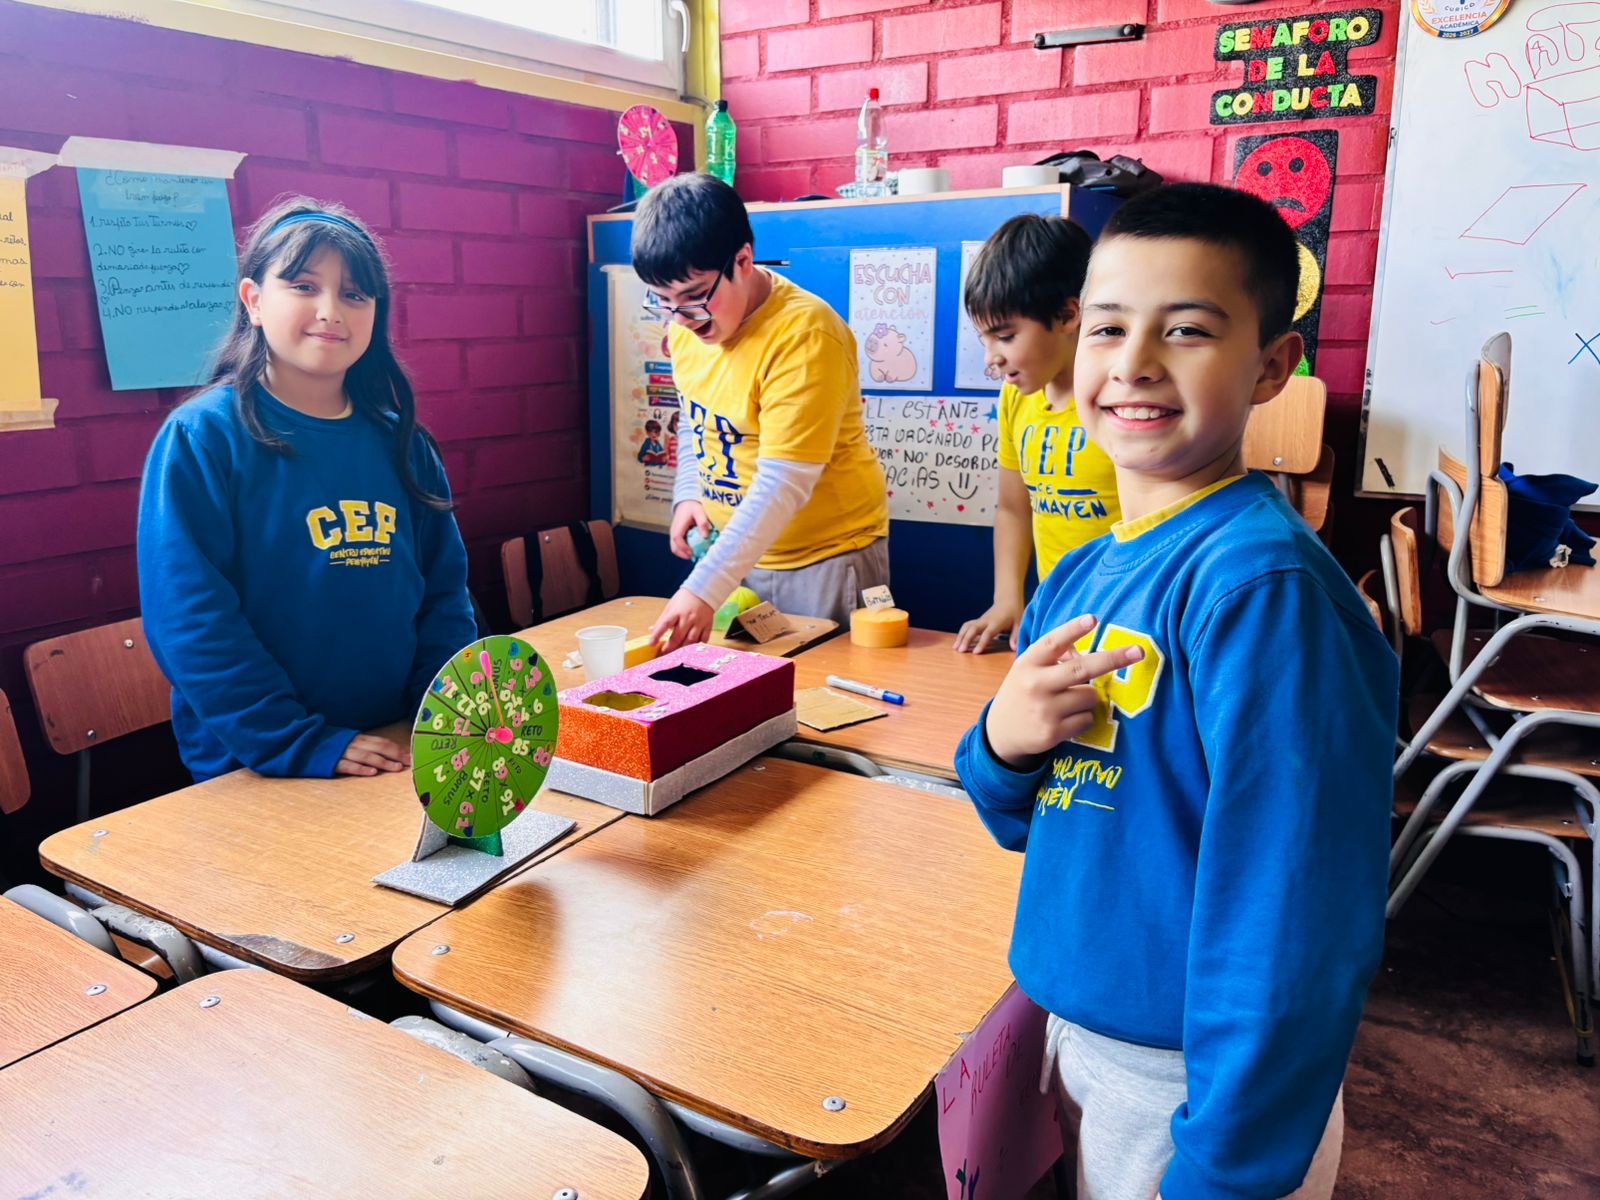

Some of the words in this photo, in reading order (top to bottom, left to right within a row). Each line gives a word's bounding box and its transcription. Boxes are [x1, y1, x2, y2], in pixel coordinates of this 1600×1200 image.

[1431, 12, 1487, 25] EXCELENCIA
[1219, 16, 1369, 53] SEMAFORO
[1249, 57, 1285, 82] DE
[1297, 51, 1336, 76] LA
[1215, 83, 1362, 117] CONDUCTA
[108, 245, 126, 256] NO
[854, 263, 932, 285] ESCUCHA
[873, 284, 911, 306] CON
[115, 304, 133, 317] NO
[904, 450, 924, 464] NO
[1020, 425, 1087, 476] CEP
[306, 500, 396, 550] CEP
[521, 725, 543, 737] RETO
[431, 738, 457, 752] RETO
